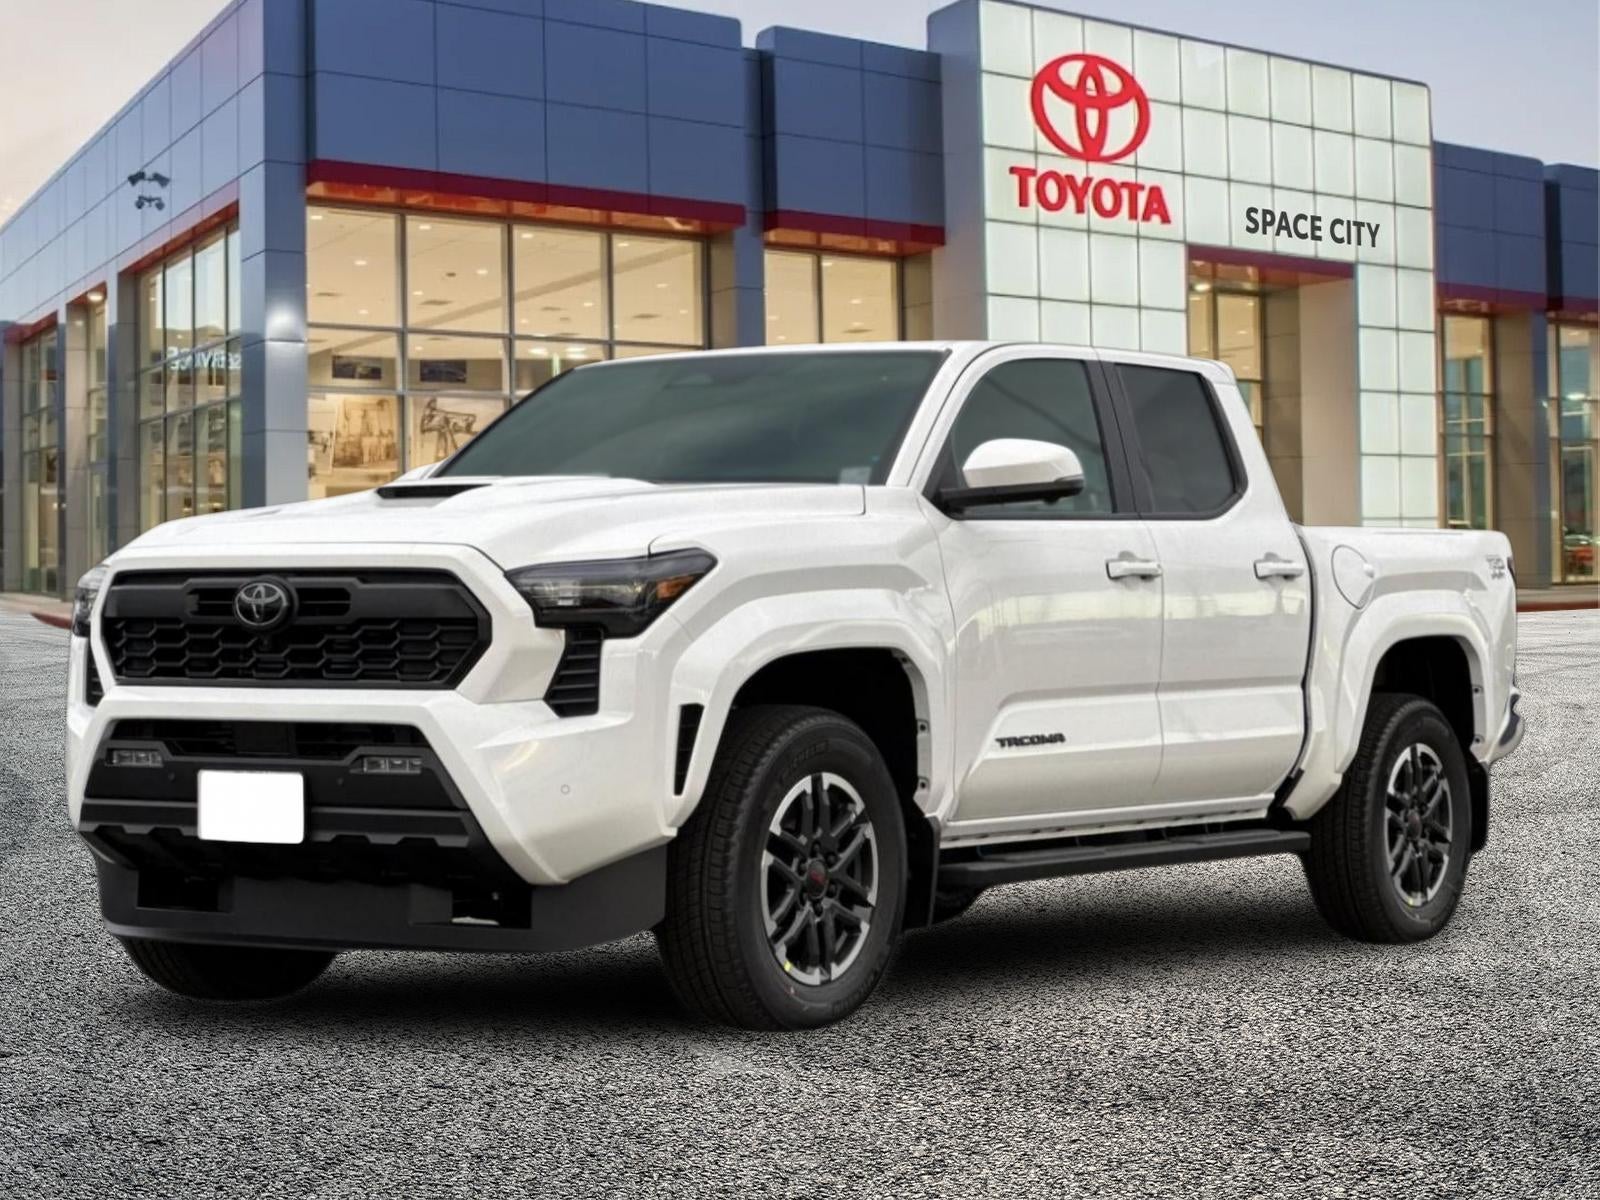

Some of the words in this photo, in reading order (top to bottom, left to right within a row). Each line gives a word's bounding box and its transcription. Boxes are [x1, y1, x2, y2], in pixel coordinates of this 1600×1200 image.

[1009, 166, 1171, 225] TOYOTA
[1245, 206, 1323, 242] SPACE
[1329, 217, 1381, 248] CITY
[995, 732, 1066, 748] TACOMA
